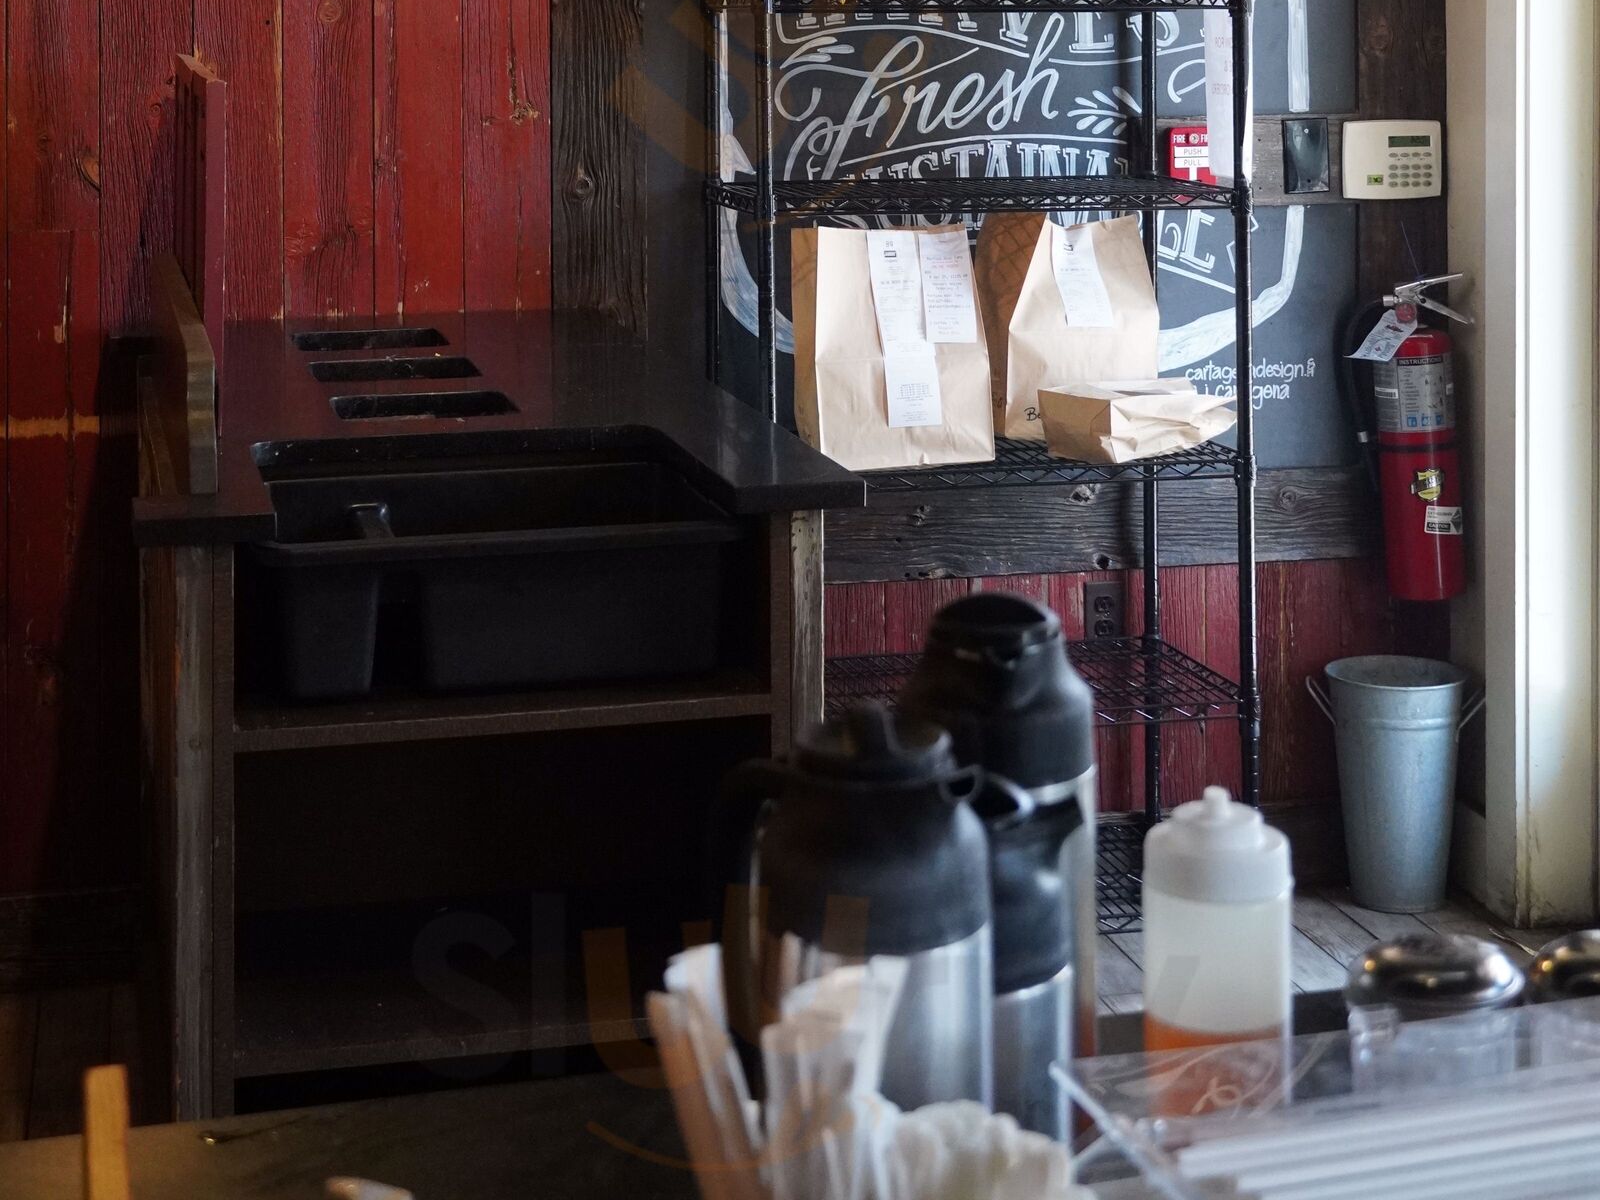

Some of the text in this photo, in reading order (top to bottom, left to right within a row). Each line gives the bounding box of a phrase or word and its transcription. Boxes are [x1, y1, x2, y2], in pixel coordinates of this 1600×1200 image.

[1173, 133, 1186, 144] FIRE
[1183, 148, 1202, 156] PUSH
[1183, 159, 1202, 167] PULL
